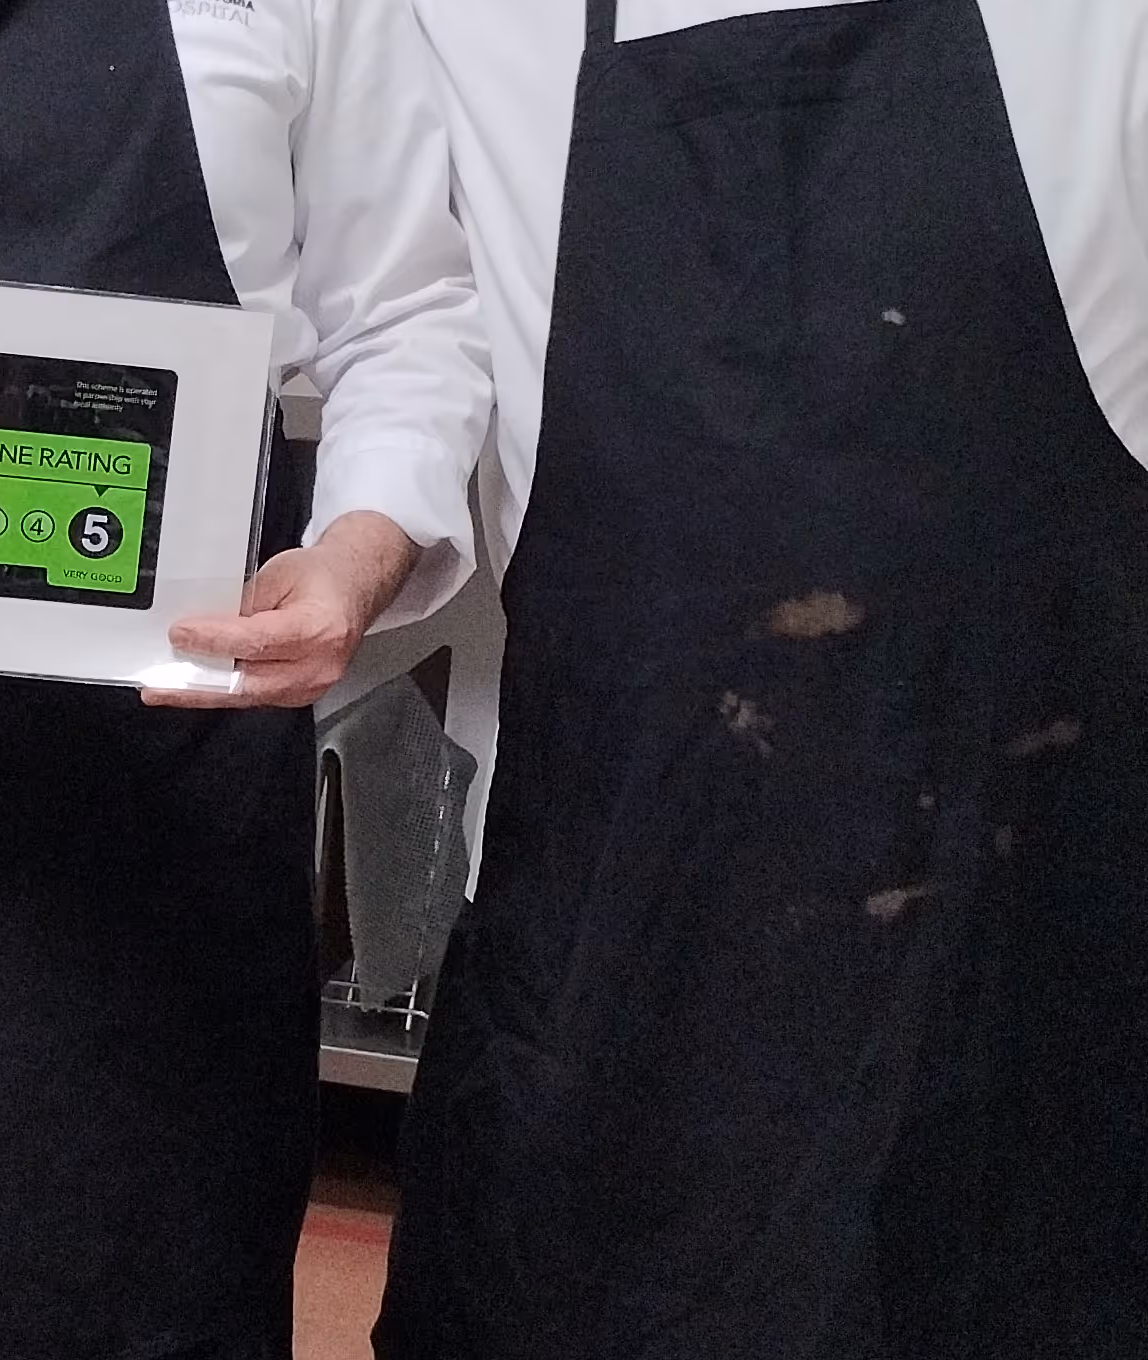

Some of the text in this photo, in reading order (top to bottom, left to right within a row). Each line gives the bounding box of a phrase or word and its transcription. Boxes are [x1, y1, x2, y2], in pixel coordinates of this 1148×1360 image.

[39, 448, 132, 475] RATING
[29, 517, 44, 536] 4
[80, 513, 109, 553] 5
[63, 569, 122, 583] VERY GOOD
